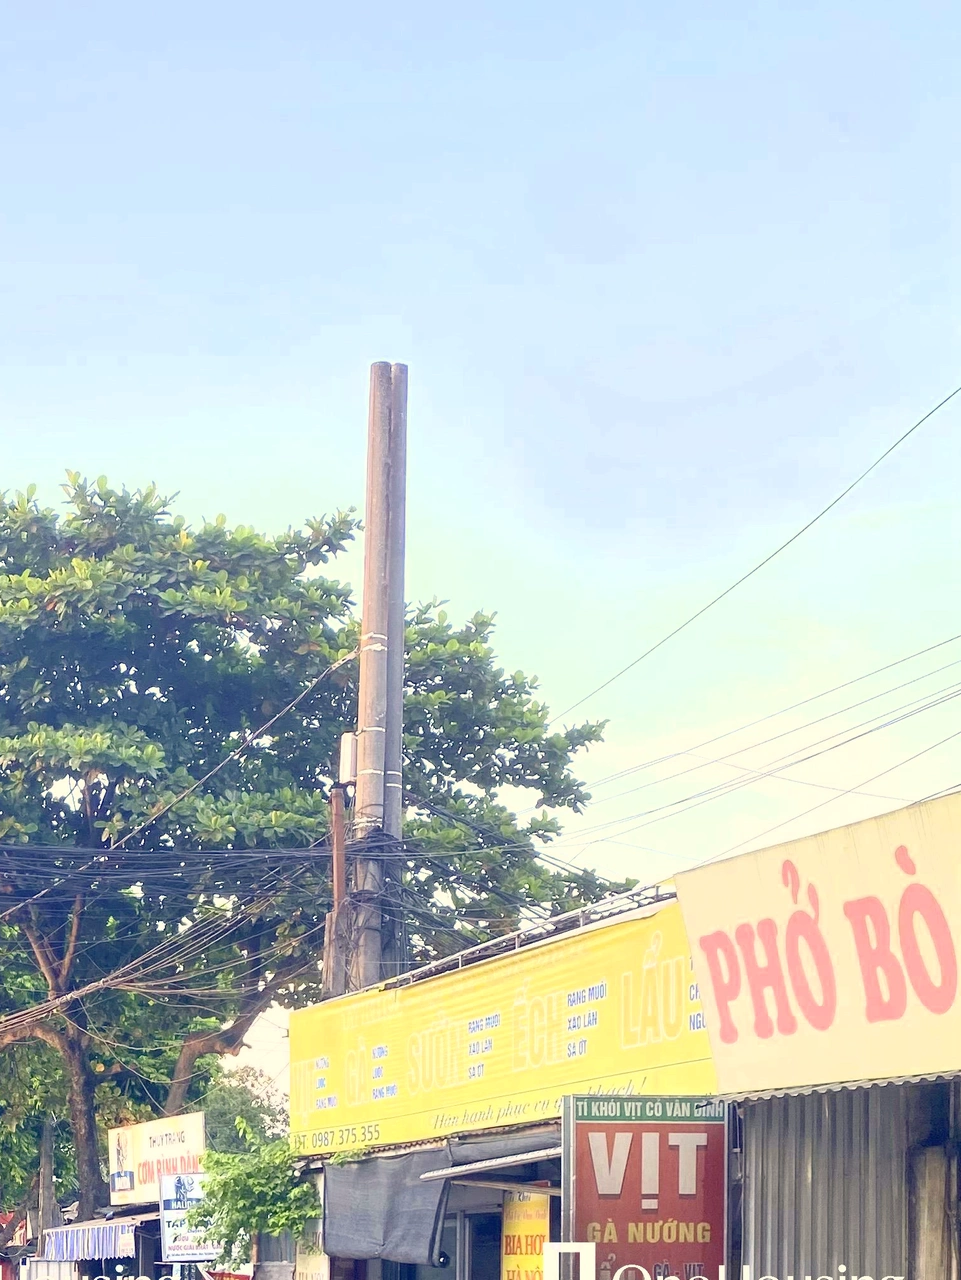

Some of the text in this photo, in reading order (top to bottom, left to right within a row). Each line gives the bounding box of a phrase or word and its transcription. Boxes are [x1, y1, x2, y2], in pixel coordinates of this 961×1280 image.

[699, 845, 958, 1044] PHỞ BÒ
[620, 930, 686, 1050] LẨU
[591, 1098, 621, 1117] KHÓI
[624, 1101, 643, 1120] VỊT
[666, 1099, 691, 1117] VÂN
[311, 1124, 381, 1149] 0987.375.355
[138, 1159, 156, 1186] CƠM
[587, 1131, 708, 1210] VỊT
[587, 1218, 712, 1244] GÀ NƯỚNG
[504, 1234, 521, 1256] BIA
